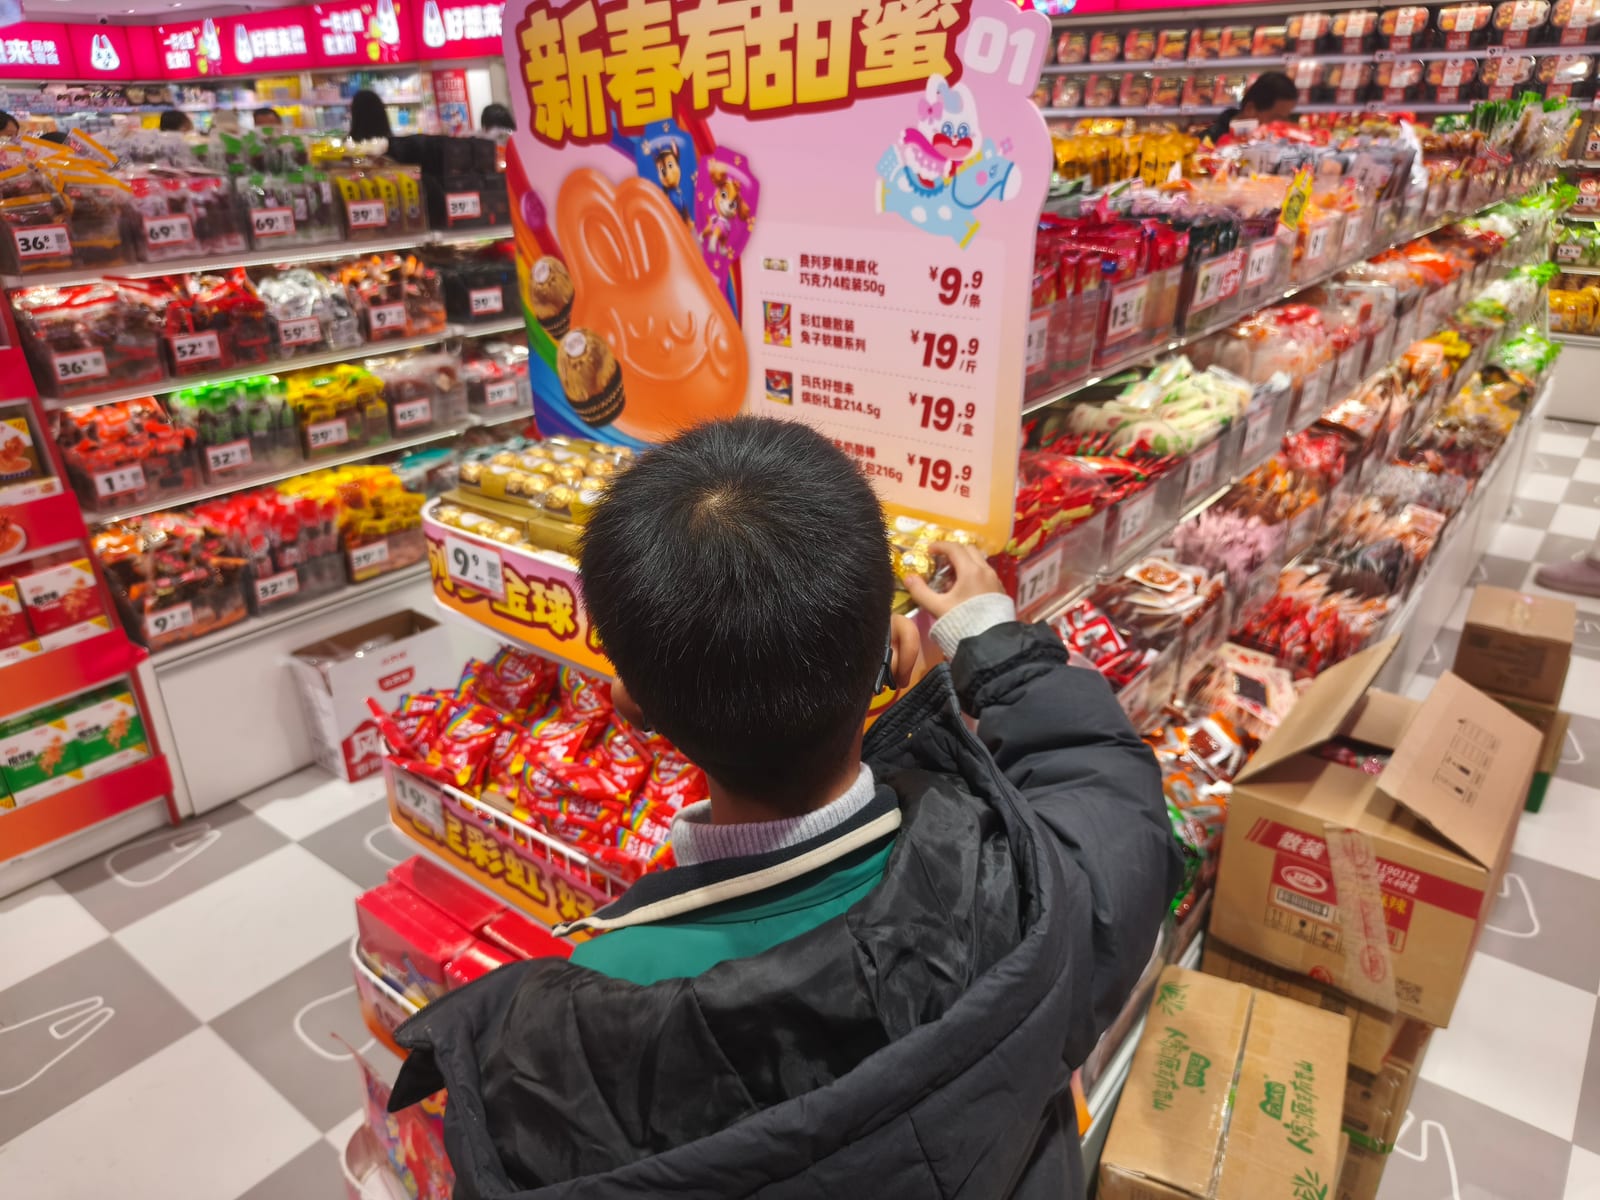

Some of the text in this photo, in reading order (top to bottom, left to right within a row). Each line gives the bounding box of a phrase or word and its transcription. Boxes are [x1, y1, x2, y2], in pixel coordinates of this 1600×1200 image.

[963, 16, 1036, 85] 01
[520, 0, 963, 141] 新春有甜蜜
[799, 253, 879, 276] 费列罗榛果威化
[799, 272, 886, 297] 巧克力4粒装50g
[800, 313, 855, 333] 彩虹糖散装
[800, 331, 867, 352] 兔子软糖系列
[801, 374, 855, 396] 玛氏好想来
